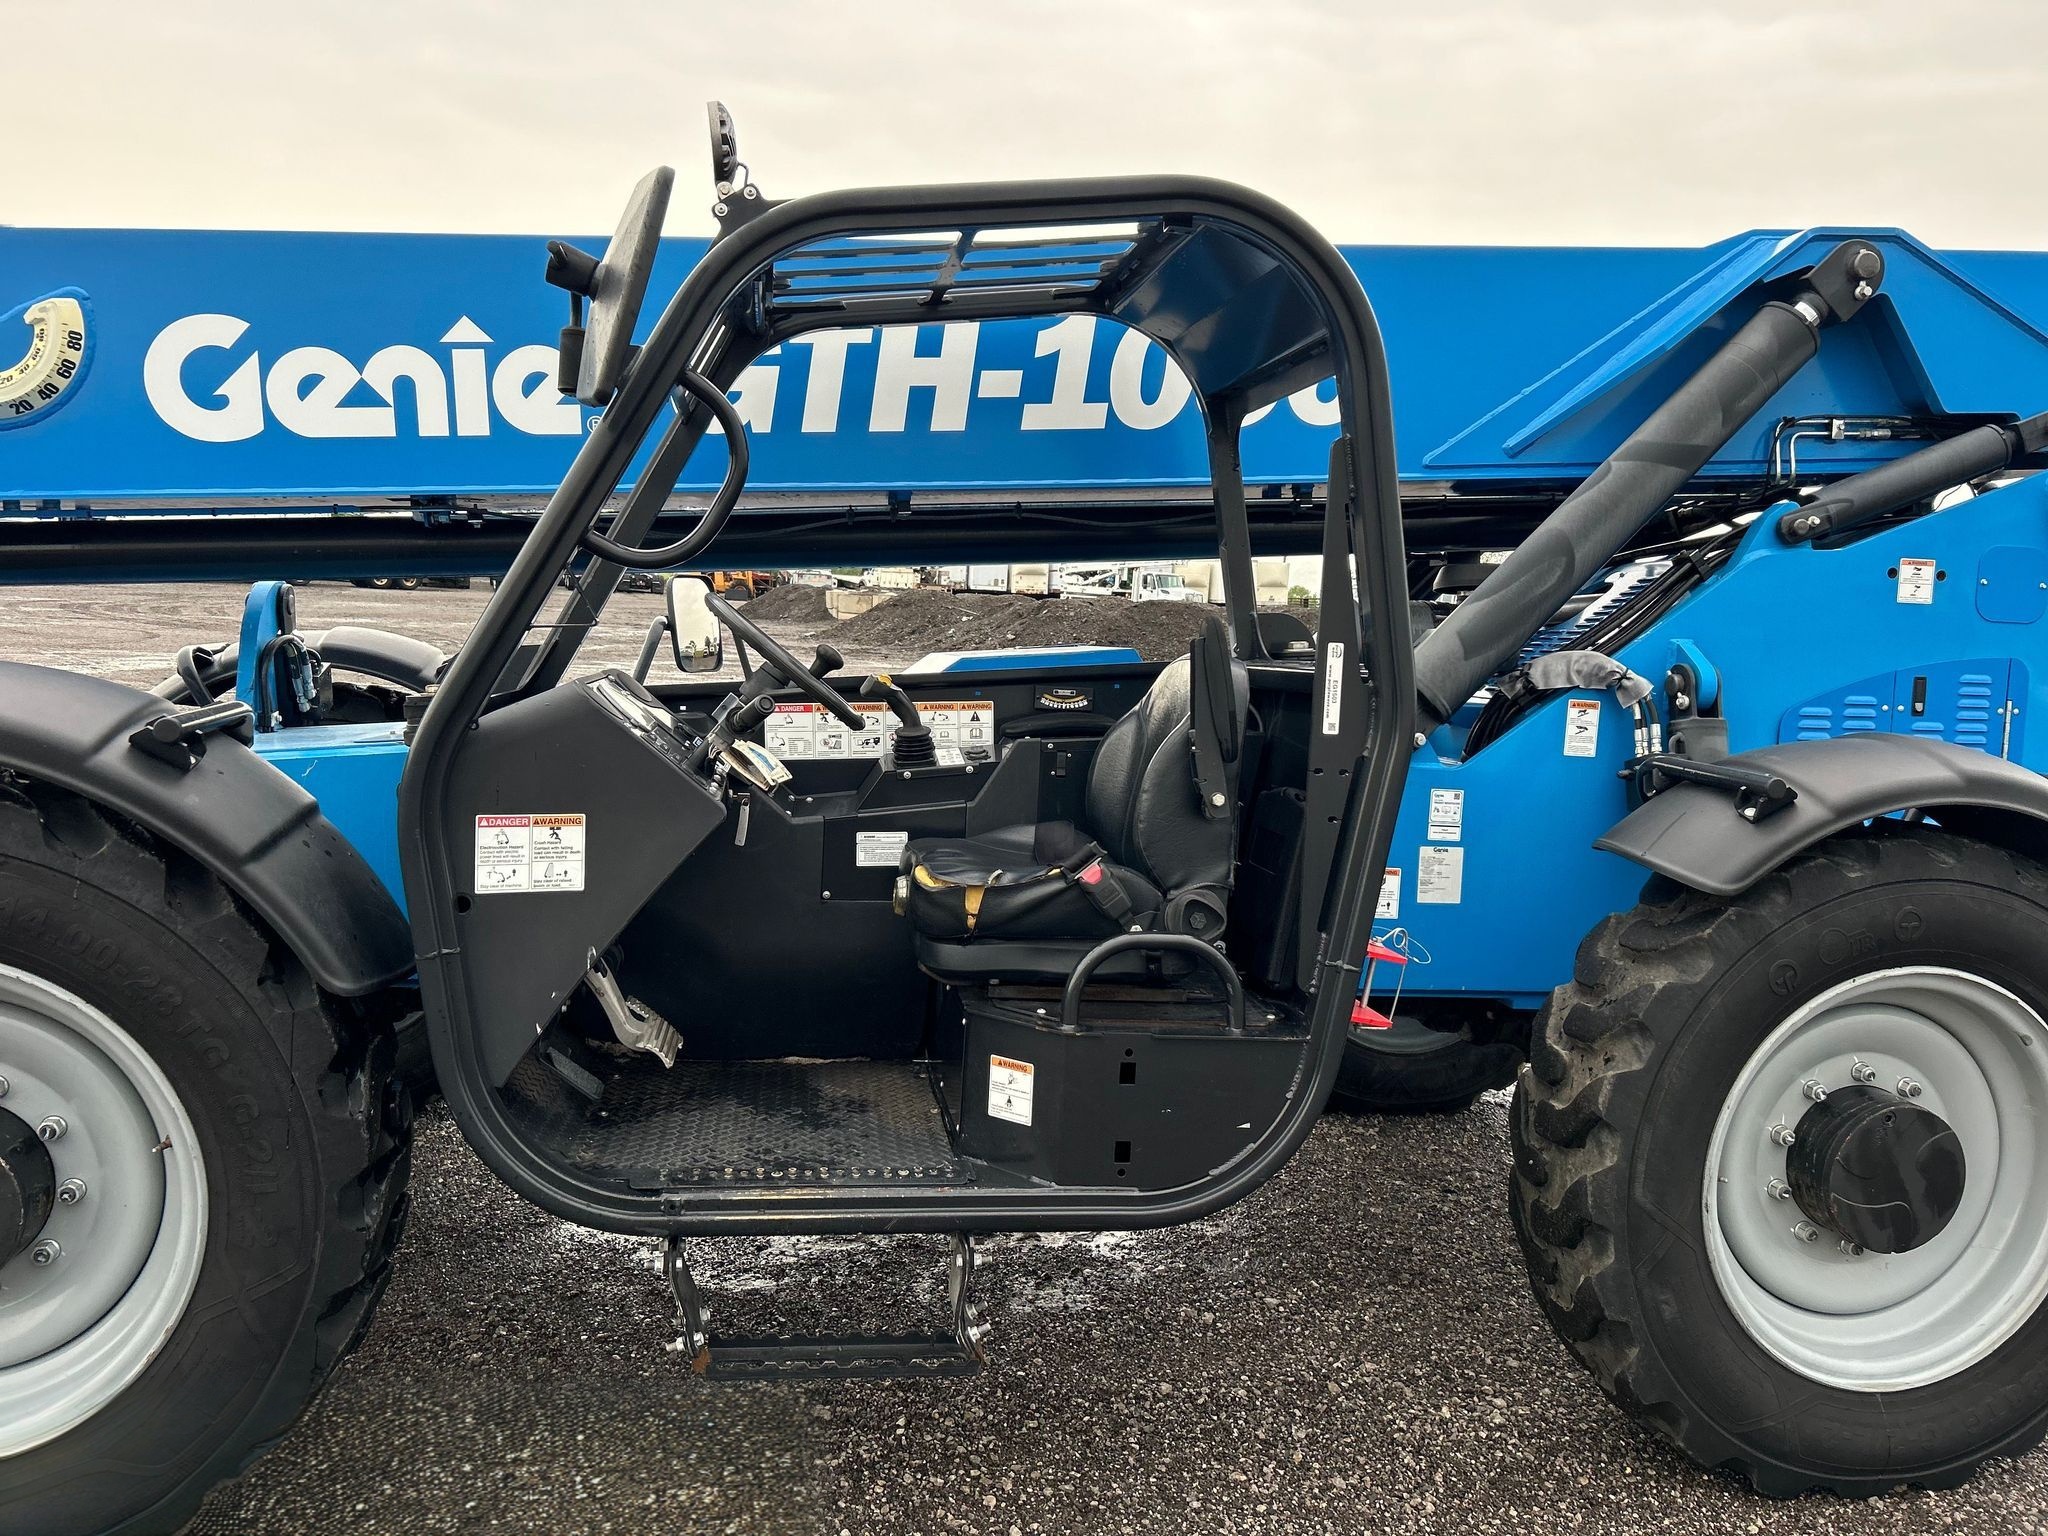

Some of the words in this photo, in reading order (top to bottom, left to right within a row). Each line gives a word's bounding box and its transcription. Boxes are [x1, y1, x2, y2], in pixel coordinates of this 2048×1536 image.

[66, 330, 84, 352] 80
[56, 358, 77, 380] 60
[143, 313, 583, 443] Genie
[37, 382, 60, 401] 40
[8, 399, 35, 416] 20
[1003, 1060, 1028, 1072] WARNING
